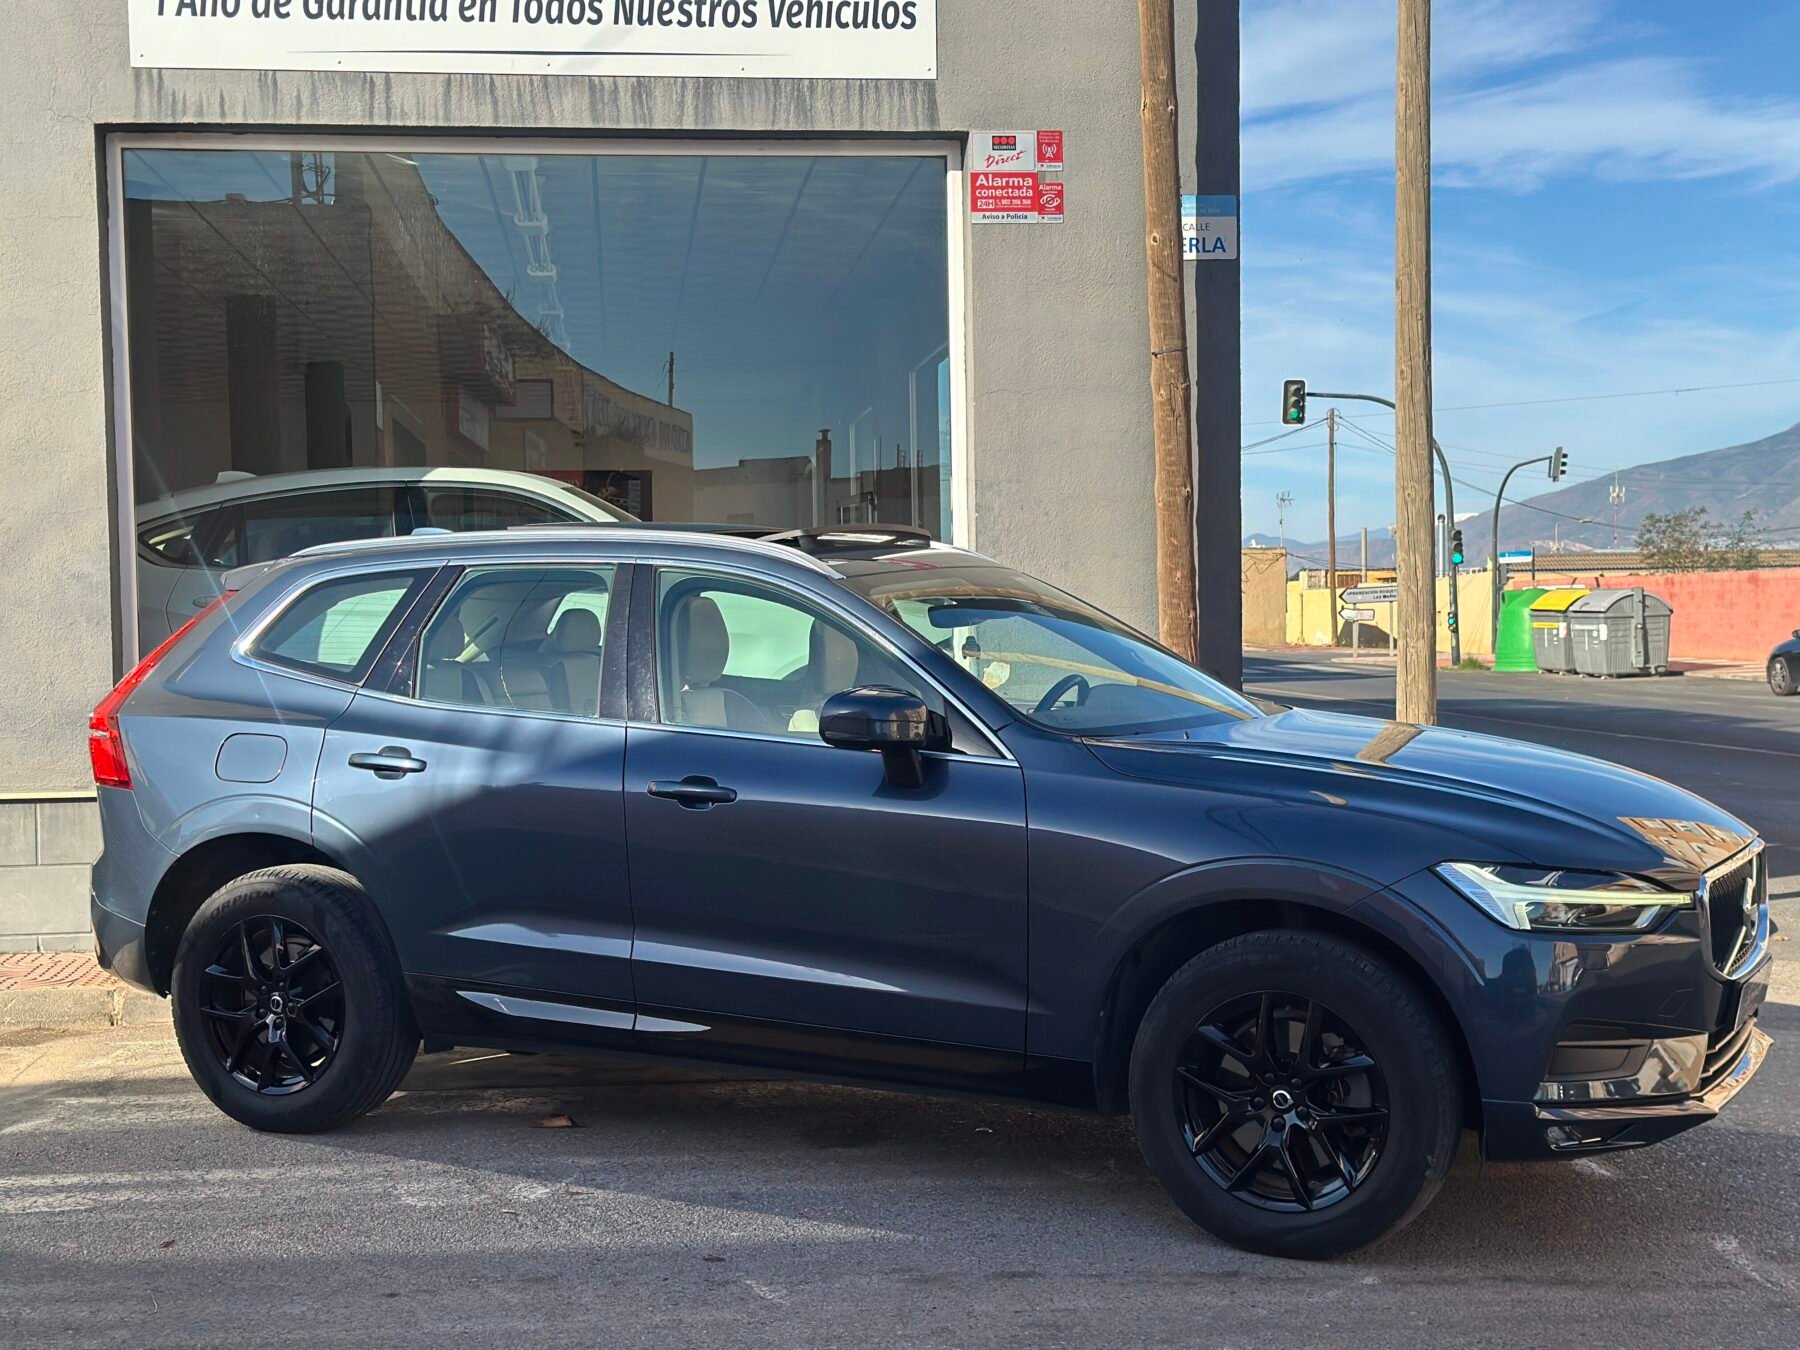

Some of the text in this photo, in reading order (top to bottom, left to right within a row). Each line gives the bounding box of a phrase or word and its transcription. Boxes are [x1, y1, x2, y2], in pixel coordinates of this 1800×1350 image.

[458, 0, 497, 23] en
[613, 0, 758, 28] Nuestros
[985, 150, 1027, 168] Direct
[975, 174, 1033, 186] Alarma
[975, 187, 1033, 197] conectada
[978, 200, 994, 208] 24H
[1182, 222, 1210, 232] CALLE
